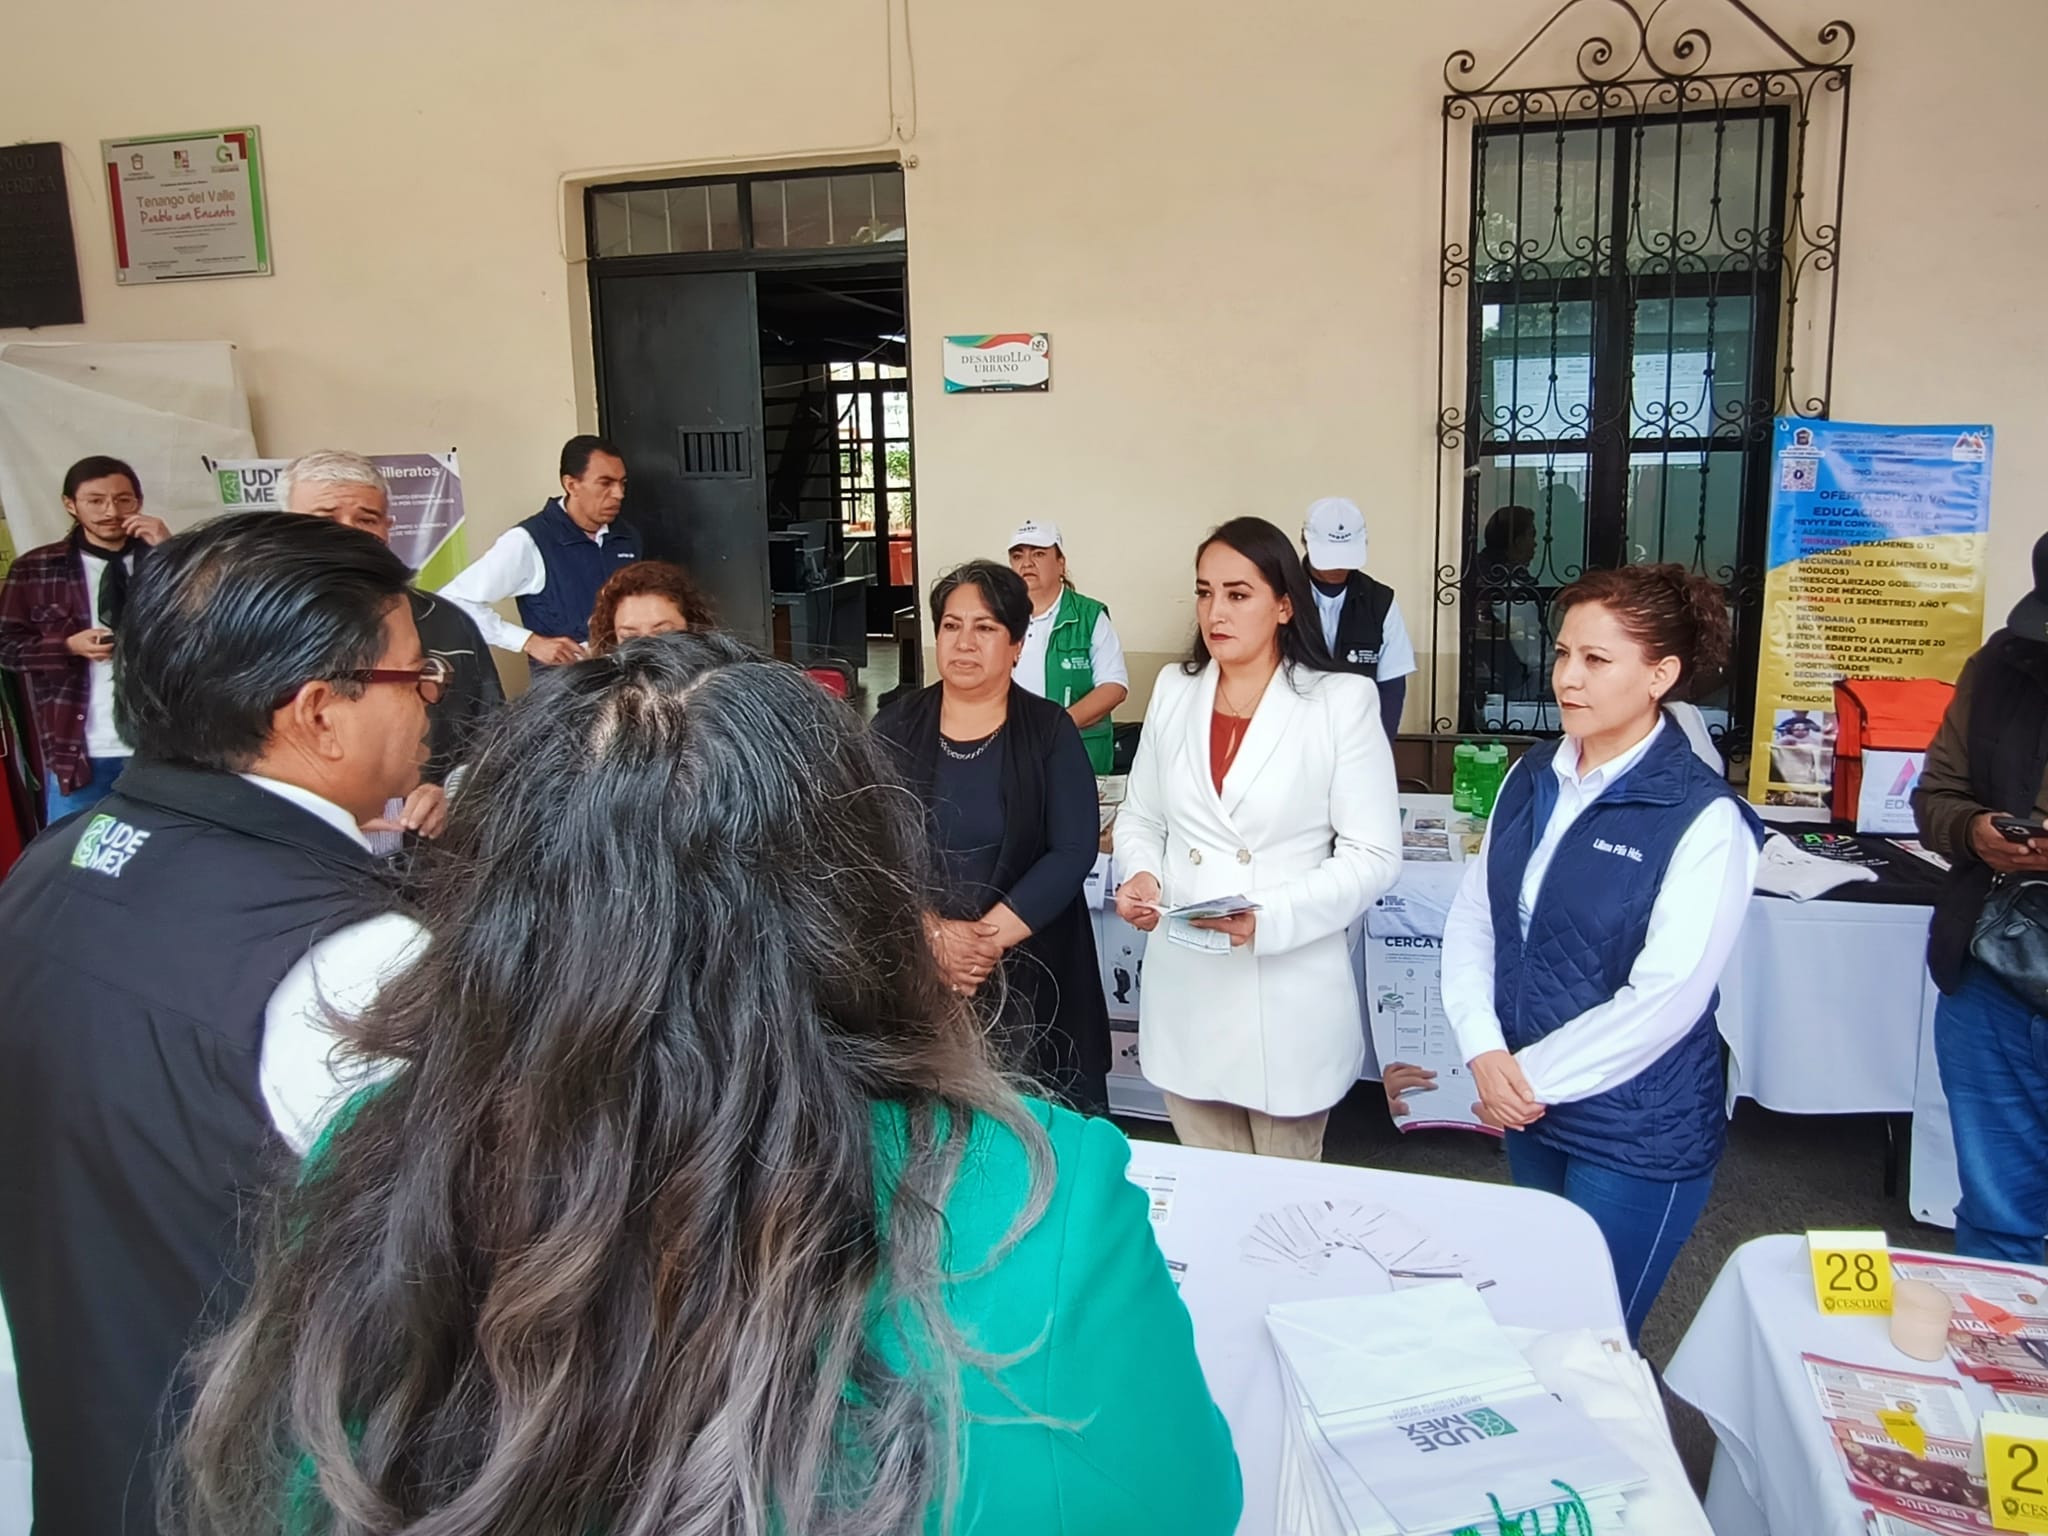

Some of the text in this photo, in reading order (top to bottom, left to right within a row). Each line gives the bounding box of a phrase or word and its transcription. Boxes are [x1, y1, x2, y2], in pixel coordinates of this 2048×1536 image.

[136, 190, 235, 209] Tenango del Valle
[175, 211, 192, 221] con
[194, 204, 236, 220] Encanto
[961, 351, 1031, 364] DESARROLLO
[974, 363, 1019, 373] URBANO
[1862, 539, 1914, 549] EXÁMENES
[1799, 546, 1852, 556] MÓDULOS)
[1799, 557, 1949, 570] SECUNDARIA (2 EXÁMENES O 12
[1798, 566, 1850, 576] MÓDULOS)
[1789, 576, 1886, 587] SEMIESCOLARIZADO
[1789, 585, 1883, 596] ESTADO DE MÉXICO:
[1856, 597, 1917, 608] SEMESTRES)
[1918, 599, 1939, 608] AÑO
[1796, 614, 1855, 623] SECUNDARIA
[1869, 617, 1928, 627] SEMESTRES)
[1797, 623, 1814, 631] AÑO
[1825, 625, 1856, 633] MEDIO
[1825, 634, 1867, 643] ABIERTO
[1869, 637, 1880, 646] (A
[1882, 638, 1917, 646] PARTIR
[1919, 639, 1932, 647] DE
[1933, 639, 1946, 647] 20
[1825, 644, 1852, 652] EDAD
[1869, 646, 1924, 656] ADELANTE)
[1794, 662, 1870, 672] OPORTUNIDADES
[1781, 694, 1832, 703] FORMACIÓN
[100, 820, 151, 855] UDE
[87, 843, 134, 878] MEX
[1385, 936, 1434, 948] CERCA
[1825, 1252, 1878, 1293] 28
[1397, 1414, 1468, 1436] MEX
[1409, 1426, 1486, 1453] UDE
